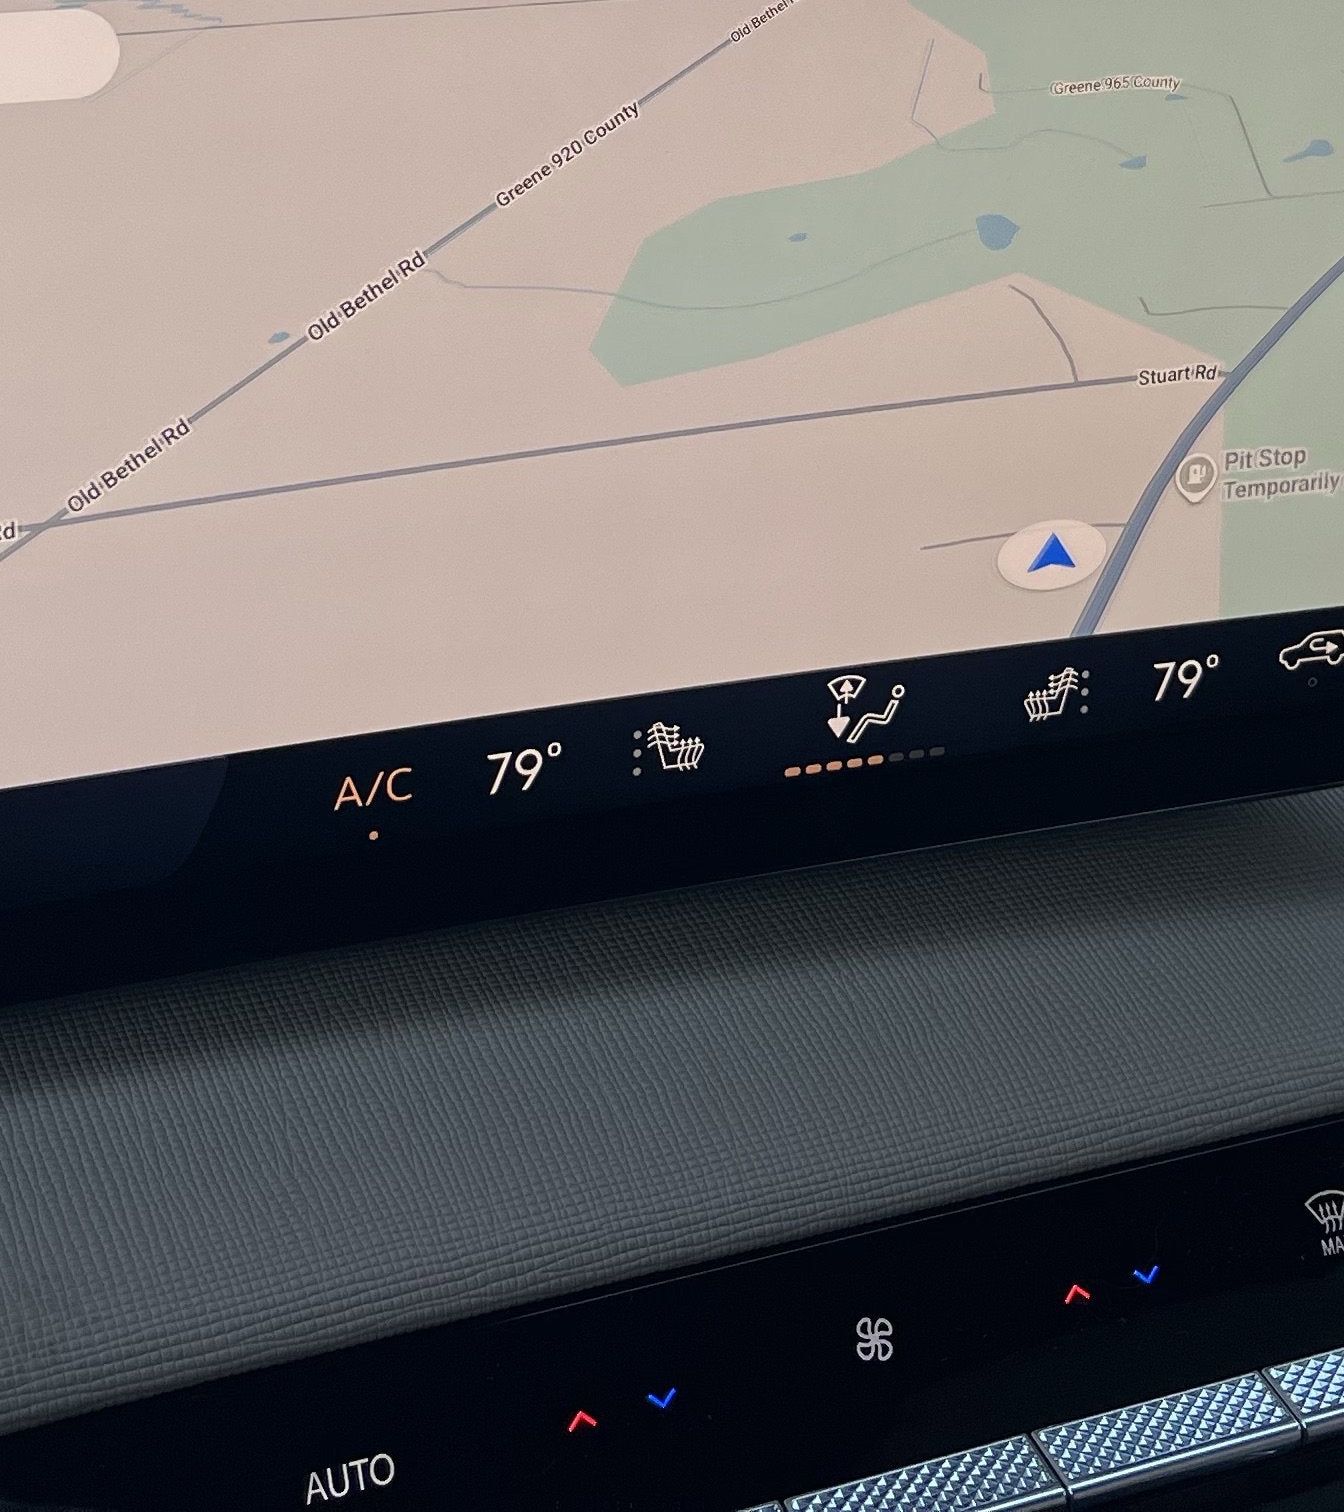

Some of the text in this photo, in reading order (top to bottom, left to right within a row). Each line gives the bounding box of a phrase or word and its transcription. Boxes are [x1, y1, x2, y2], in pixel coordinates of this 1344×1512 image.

[730, 23, 752, 43] Old
[1053, 75, 1181, 95] Greene 965 County
[496, 101, 639, 207] Greene 920 County
[308, 250, 426, 341] Old Bethel Rd
[1139, 364, 1218, 386] Stuart Rd
[67, 418, 191, 513] Old Bethel Rd
[1225, 448, 1307, 471] Pit Stop
[1223, 471, 1341, 500] Temporarily
[1153, 654, 1220, 702] 79°
[333, 767, 413, 812] A/C
[486, 741, 562, 796] 79°
[305, 1453, 396, 1506] AUTO
